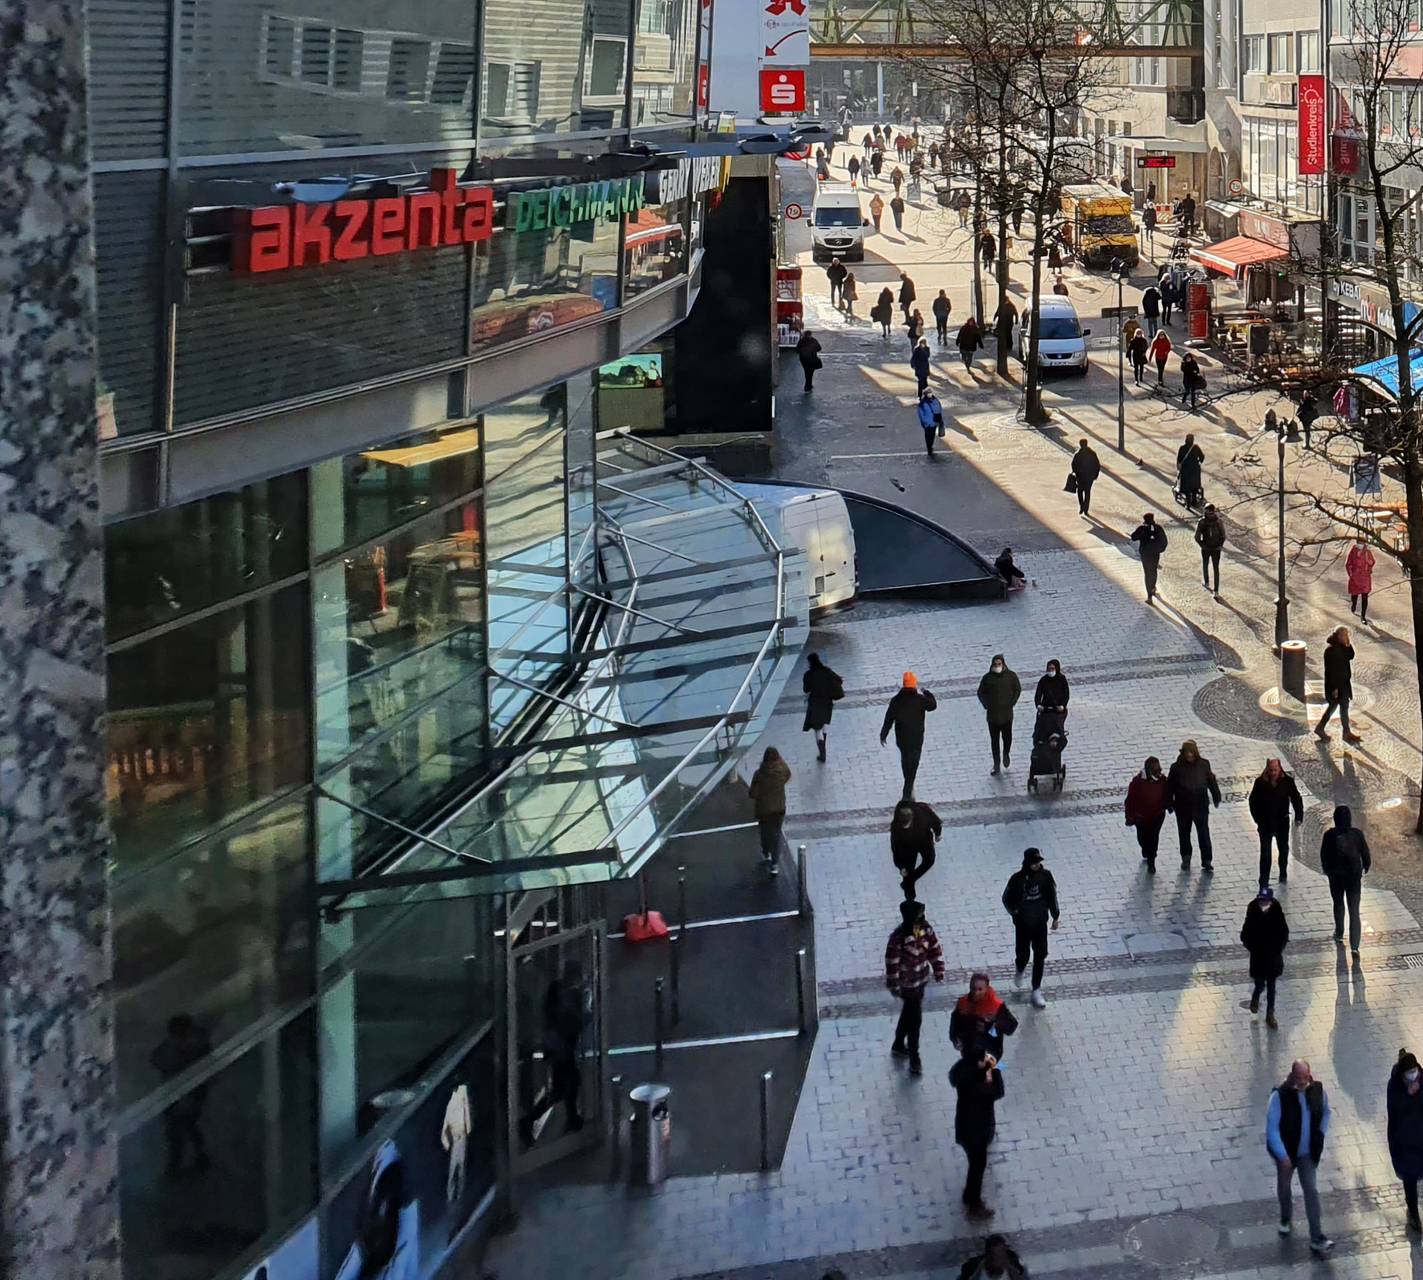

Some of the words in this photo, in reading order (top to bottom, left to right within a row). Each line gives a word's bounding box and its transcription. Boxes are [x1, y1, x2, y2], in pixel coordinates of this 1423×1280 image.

[1306, 98, 1318, 165] Studienkreis
[517, 173, 645, 233] DEICHMANN
[659, 158, 691, 206] GERRY
[692, 156, 721, 195] WEBER
[251, 168, 493, 272] akzenta
